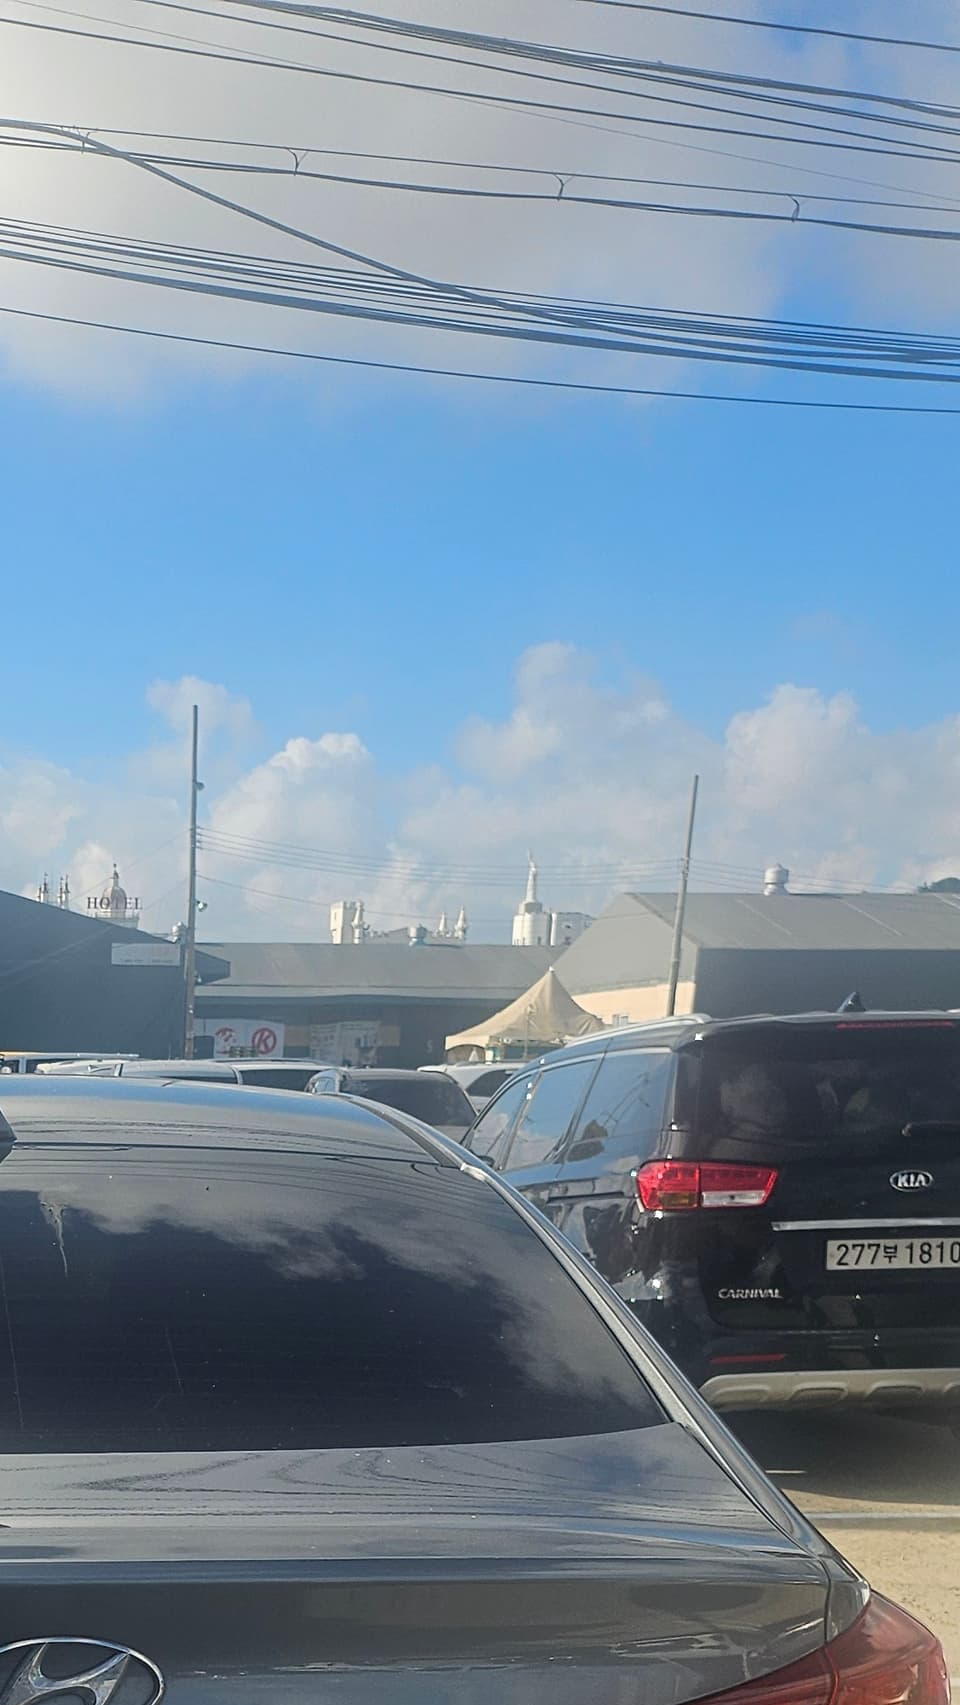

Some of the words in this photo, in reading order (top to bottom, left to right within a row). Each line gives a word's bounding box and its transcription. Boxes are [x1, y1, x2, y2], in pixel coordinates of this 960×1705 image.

[87, 897, 143, 910] HOTEL
[895, 1171, 929, 1189] KIA
[836, 1242, 898, 1266] 277부
[905, 1240, 960, 1264] 1810
[718, 1288, 783, 1300] CARNIVAL
